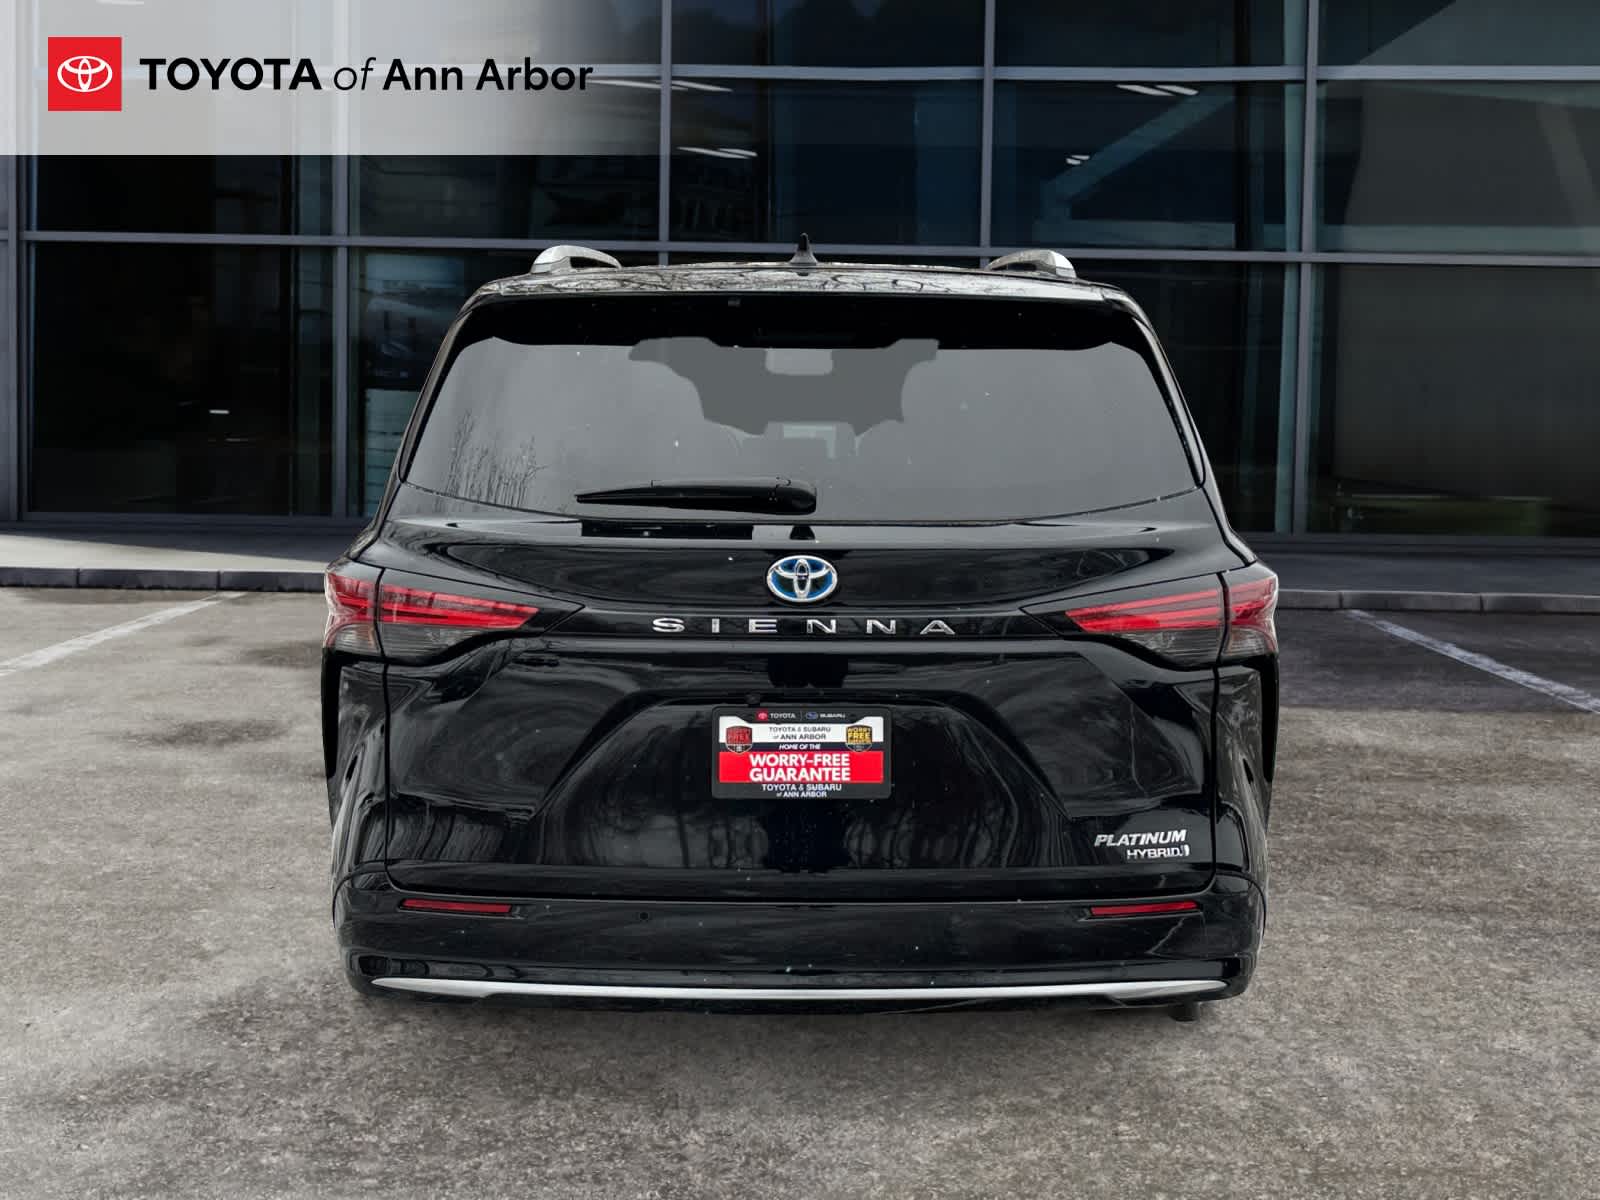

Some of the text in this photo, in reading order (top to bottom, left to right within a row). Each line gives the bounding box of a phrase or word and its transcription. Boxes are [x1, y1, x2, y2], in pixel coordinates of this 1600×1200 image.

[652, 617, 955, 635] SIENNA
[749, 753, 850, 767] WORRY-FREE
[749, 767, 851, 782] GUARANTEE
[761, 783, 797, 791] TOYOTA
[806, 783, 842, 791] SUBARU
[1094, 829, 1187, 846] PLATINUM
[1126, 847, 1184, 859] HYBRID
